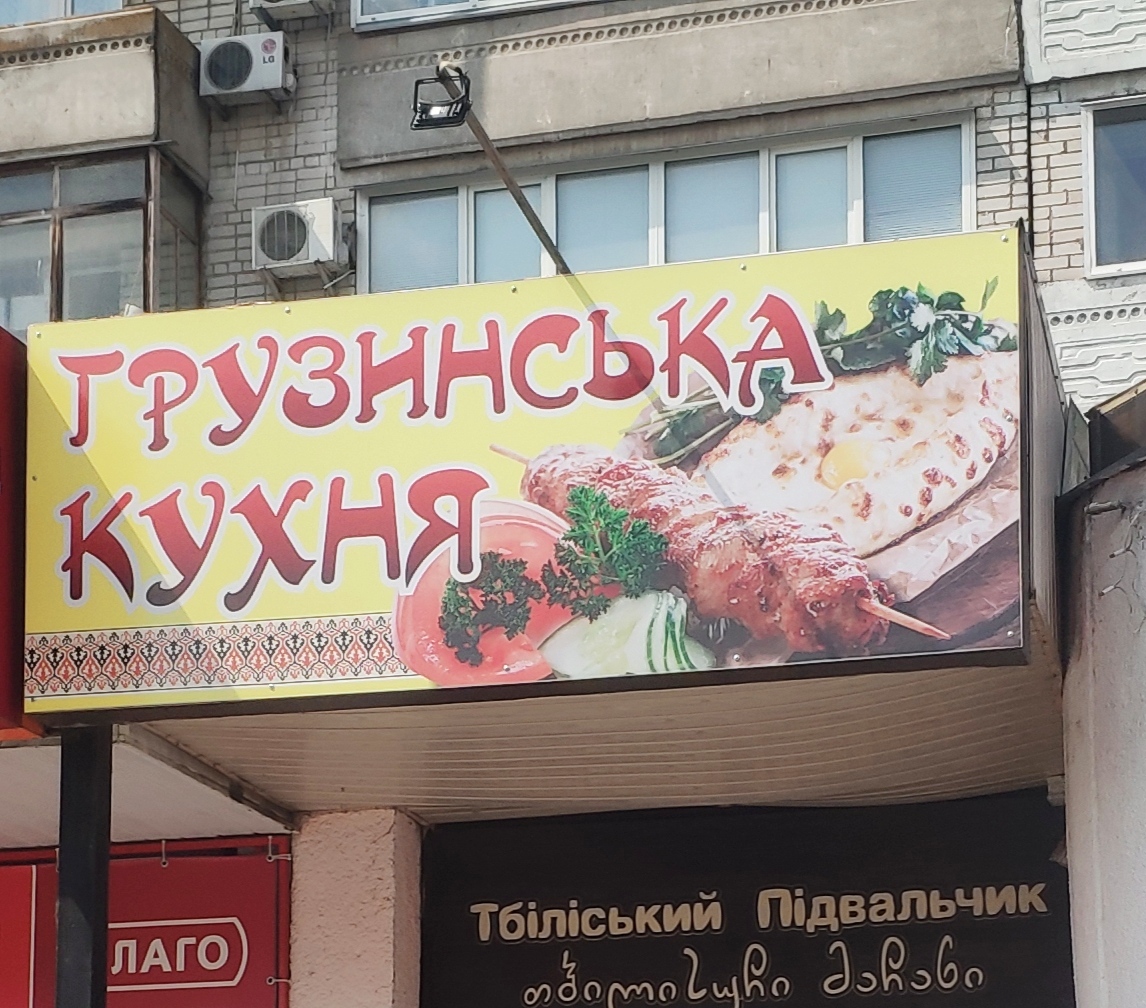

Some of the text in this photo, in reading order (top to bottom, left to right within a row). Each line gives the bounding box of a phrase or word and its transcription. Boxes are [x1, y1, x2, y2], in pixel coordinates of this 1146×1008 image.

[262, 54, 275, 64] LG
[59, 293, 826, 453] ГРУЗИНСЬКА
[61, 467, 486, 611] КУХНЯ
[471, 881, 1049, 941] Тбіліський Підвальчик
[111, 934, 229, 976] ЛАГО
